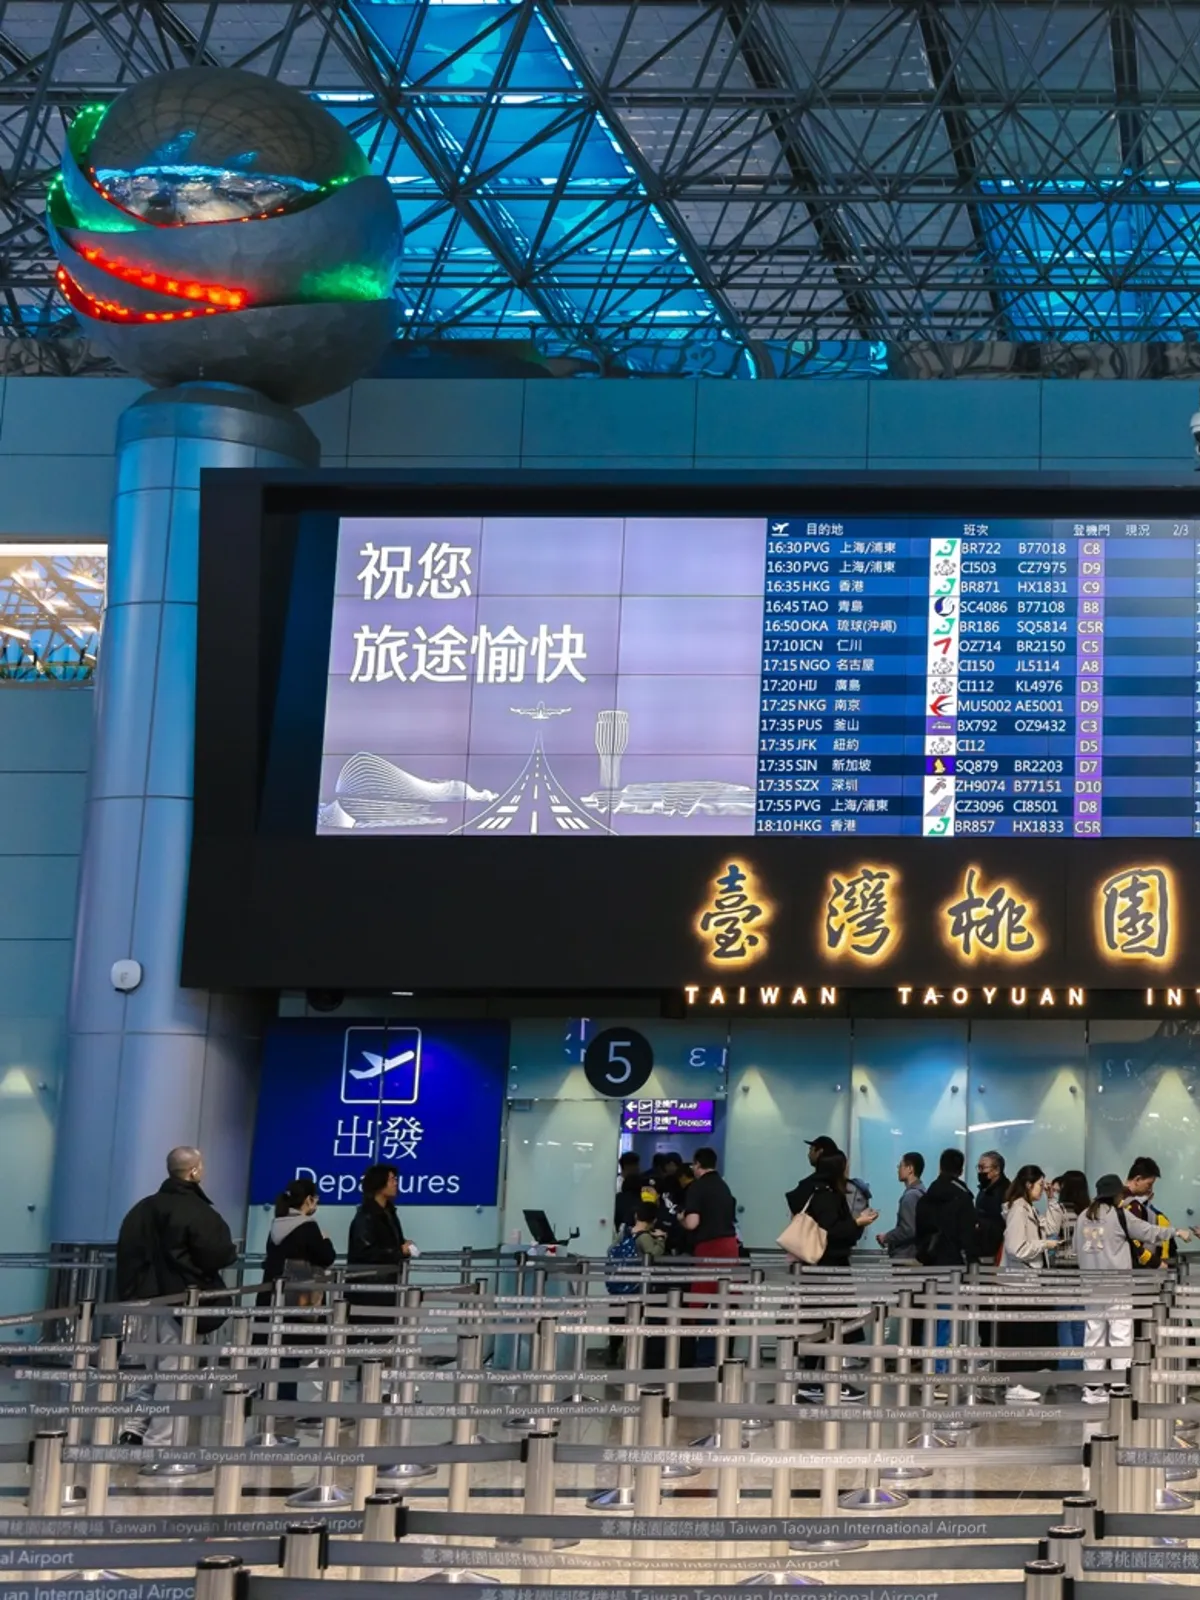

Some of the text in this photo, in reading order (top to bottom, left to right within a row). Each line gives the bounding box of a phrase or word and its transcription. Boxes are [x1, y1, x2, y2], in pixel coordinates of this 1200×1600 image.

[768, 541, 802, 554] 16:30
[802, 541, 830, 553] PVG
[962, 542, 1002, 555] BR722
[1018, 542, 1066, 555] B77018
[1082, 542, 1102, 555] C8
[357, 542, 472, 600] 祝您
[766, 580, 800, 593] 16:35
[802, 580, 832, 592] HKG
[960, 580, 1000, 593] BR871
[1018, 581, 1068, 593] HX1831
[1082, 581, 1100, 594] C9
[764, 619, 800, 632] 16:50
[800, 619, 830, 632] OKA
[960, 620, 1000, 633] BR186
[1016, 620, 1068, 634] SQ5814
[1076, 621, 1104, 633] C5R
[349, 624, 588, 684] 旅途愉快
[762, 679, 796, 692] 17:20
[798, 679, 818, 692] HIJ
[956, 679, 994, 692] CI112
[1014, 679, 1064, 693] KL4976
[1080, 680, 1100, 693] D3
[760, 738, 796, 752] 17:35
[794, 739, 818, 751] JFK
[956, 739, 986, 752] CI12
[1078, 740, 1098, 753] D5
[758, 779, 794, 792] 17:35
[794, 779, 820, 792] SZX
[954, 779, 1006, 793] ZH9074
[1014, 779, 1062, 793] B77151
[1074, 780, 1102, 793] D10
[685, 986, 837, 1005] TAIWAN
[898, 987, 1085, 1006] TAOYUAN
[605, 1041, 632, 1084] 5
[333, 1115, 424, 1160] 出發
[119, 1372, 152, 1382] Taoyuan
[155, 1373, 207, 1381] International
[208, 1373, 237, 1383] Airport
[0, 1405, 170, 1416] aiwan Taoyuan International Airport
[158, 1450, 365, 1465] Taiwan Taoyuan International Airport
[706, 1452, 746, 1463] Taiwan
[749, 1452, 796, 1467] Taoyuan
[799, 1453, 871, 1464] International
[874, 1453, 915, 1466] Airport
[730, 1520, 778, 1534] Taiwan
[782, 1521, 840, 1537] Taoyuan
[843, 1521, 933, 1534] International
[936, 1521, 988, 1537] Airport
